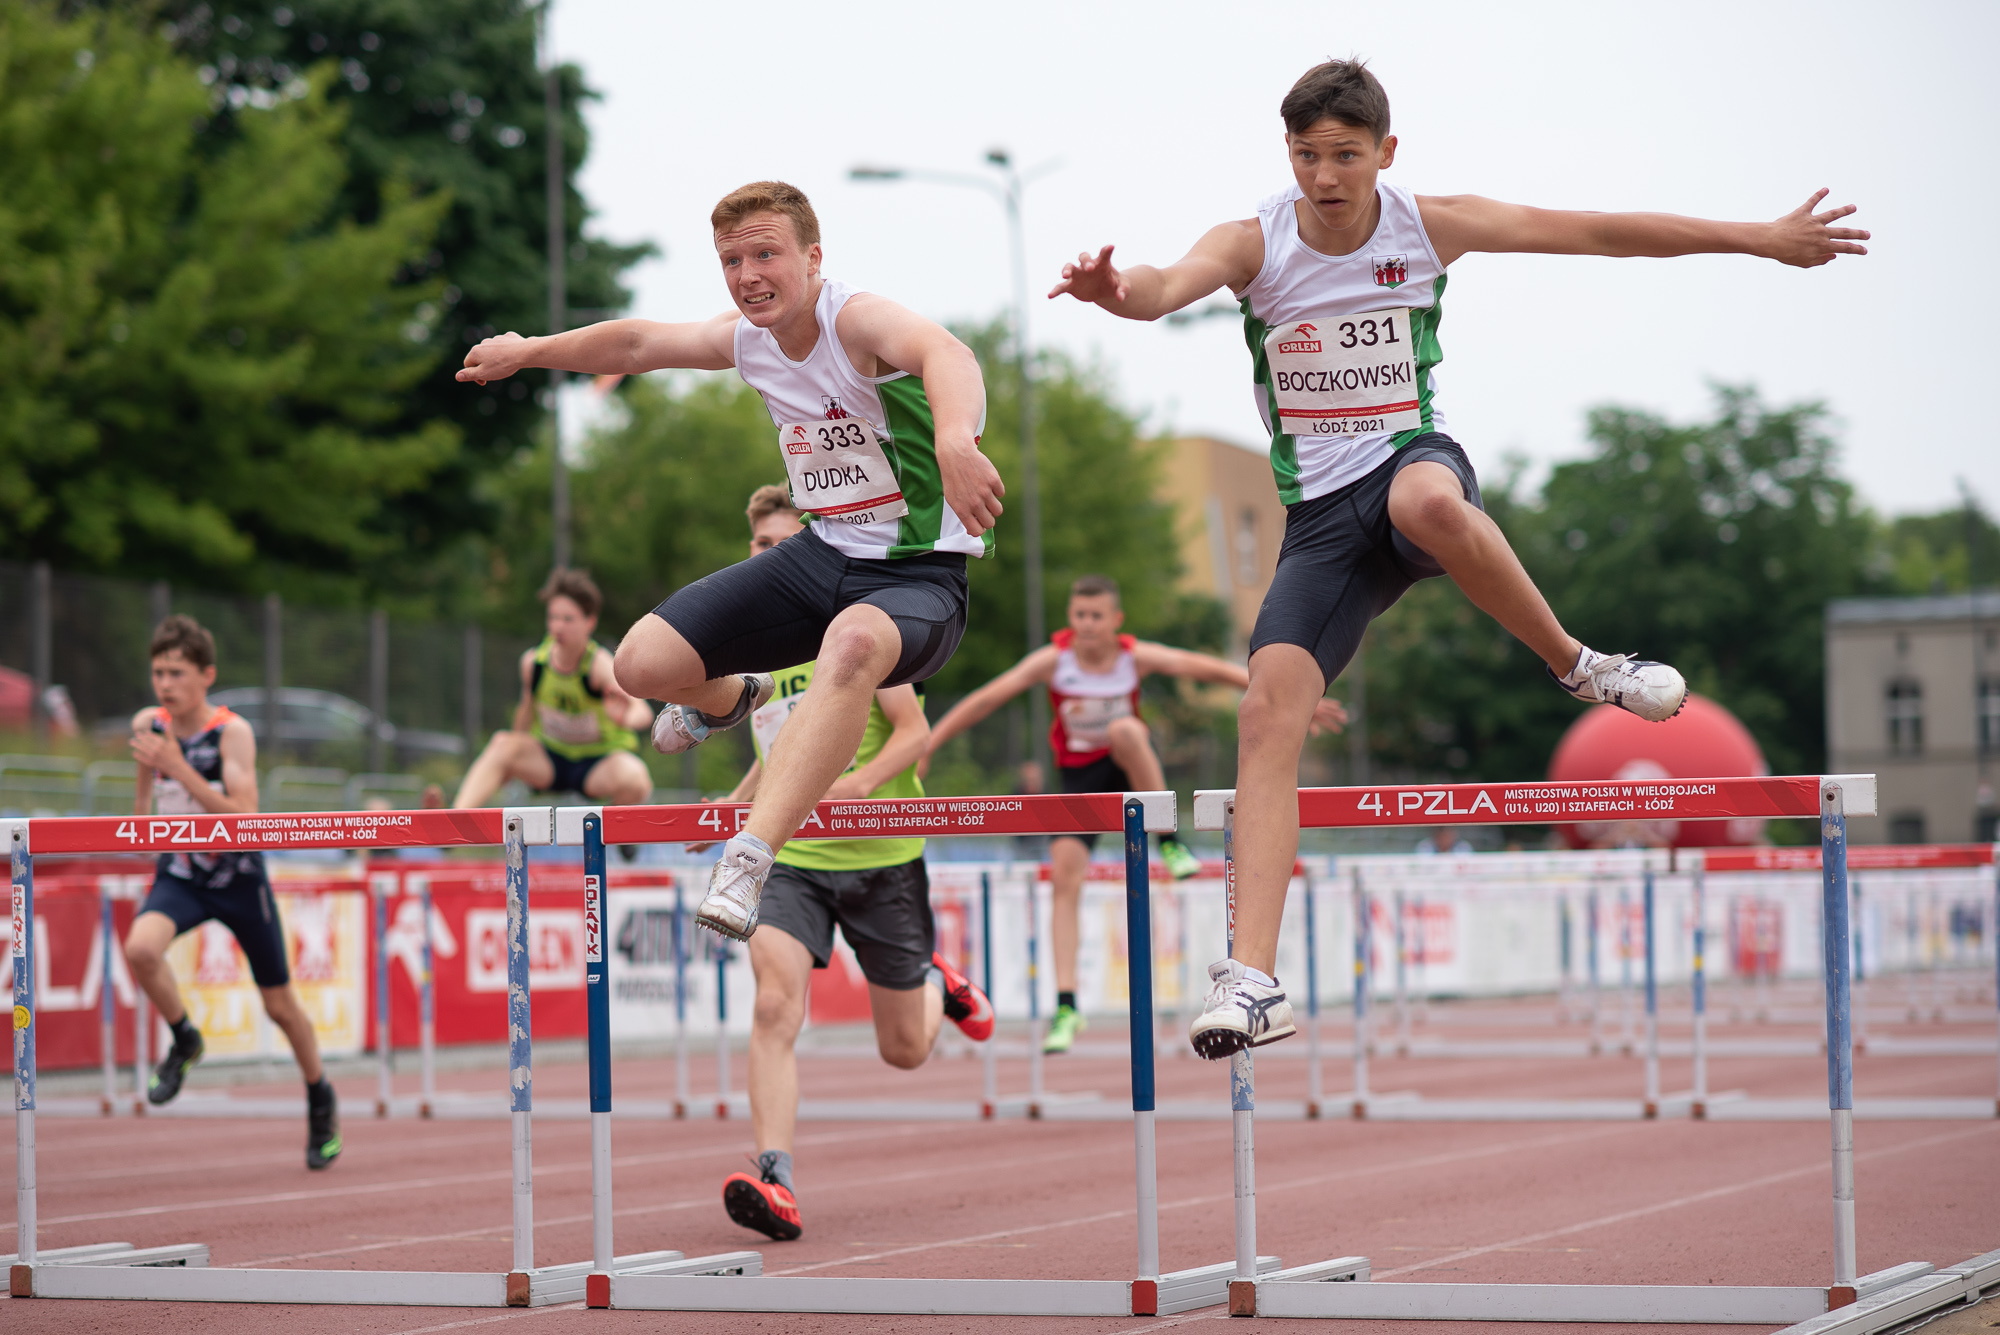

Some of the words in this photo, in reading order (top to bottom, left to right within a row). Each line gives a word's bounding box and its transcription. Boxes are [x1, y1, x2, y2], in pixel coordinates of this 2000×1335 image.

[1339, 316, 1400, 349] 331
[1280, 341, 1320, 353] ORLEN
[1277, 361, 1411, 392] BOCZKOWSKI
[818, 423, 866, 451] 333
[1313, 418, 1348, 433] ŁÓDŹ
[1353, 418, 1385, 433] 2021
[788, 443, 811, 454] ORLEN
[804, 464, 869, 492] DUDKA
[1357, 792, 1392, 817] 4.
[1397, 789, 1498, 816] PZLA
[1504, 788, 1579, 800] MISTRZOSTWA
[1582, 787, 1619, 798] POLSKI
[1621, 786, 1633, 797] W
[1634, 784, 1716, 797] WIELOBOJACH
[1504, 803, 1532, 816] (U16,
[1535, 802, 1560, 815] U20)
[1568, 800, 1634, 813] SZTAFETACH
[1645, 797, 1675, 811] ŁÓDŹ
[115, 822, 144, 844] 4.
[150, 820, 232, 844] PZLA
[236, 818, 299, 830] MISTRZOSTWA
[300, 817, 332, 829] POLSKI
[333, 817, 343, 828] W
[344, 815, 412, 828] WIELOBOJACH
[697, 809, 729, 832] 4.
[735, 808, 825, 831] PA
[830, 805, 899, 816] MISTRZOSTWA
[900, 803, 934, 814] POLSKI
[936, 803, 947, 813] W
[948, 801, 1022, 813] WIELOBOJACH
[830, 818, 856, 831] (U16,
[858, 817, 881, 830] U20)
[888, 816, 948, 828] SZTAFETACH
[957, 813, 985, 826] ŁÓDŹ
[236, 831, 261, 845] (U16,
[262, 831, 283, 844] U20)
[289, 830, 345, 842] SZTAFETACH
[352, 826, 378, 840] ŁÓDŹ
[585, 877, 600, 956] POLANIK
